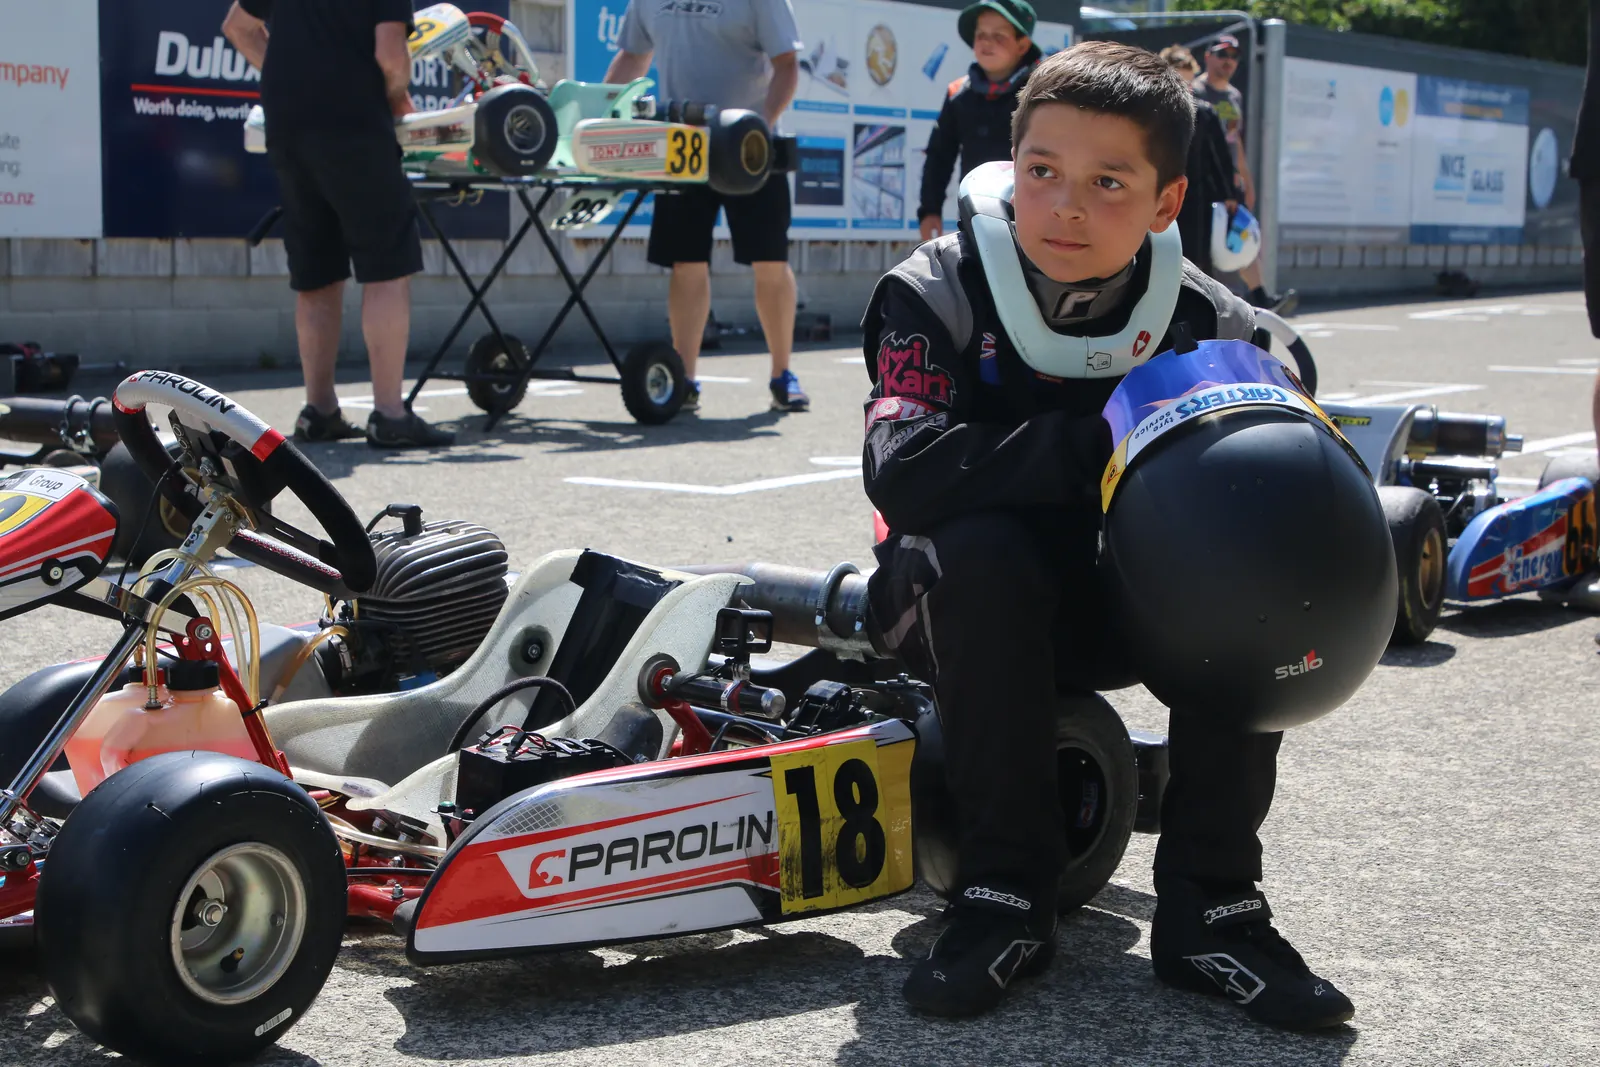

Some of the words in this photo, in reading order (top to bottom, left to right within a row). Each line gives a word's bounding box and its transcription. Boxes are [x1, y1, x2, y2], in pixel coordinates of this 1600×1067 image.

[133, 97, 174, 115] Worth
[176, 99, 215, 122] doing,
[671, 130, 703, 174] 38
[138, 371, 236, 415] PAROLIN
[883, 362, 951, 398] Kart
[1135, 410, 1171, 440] service
[1153, 416, 1174, 433] tyre
[29, 474, 63, 493] Group
[785, 757, 886, 900] 18
[569, 810, 774, 883] PAROLIN
[964, 886, 1032, 911] alpinestars
